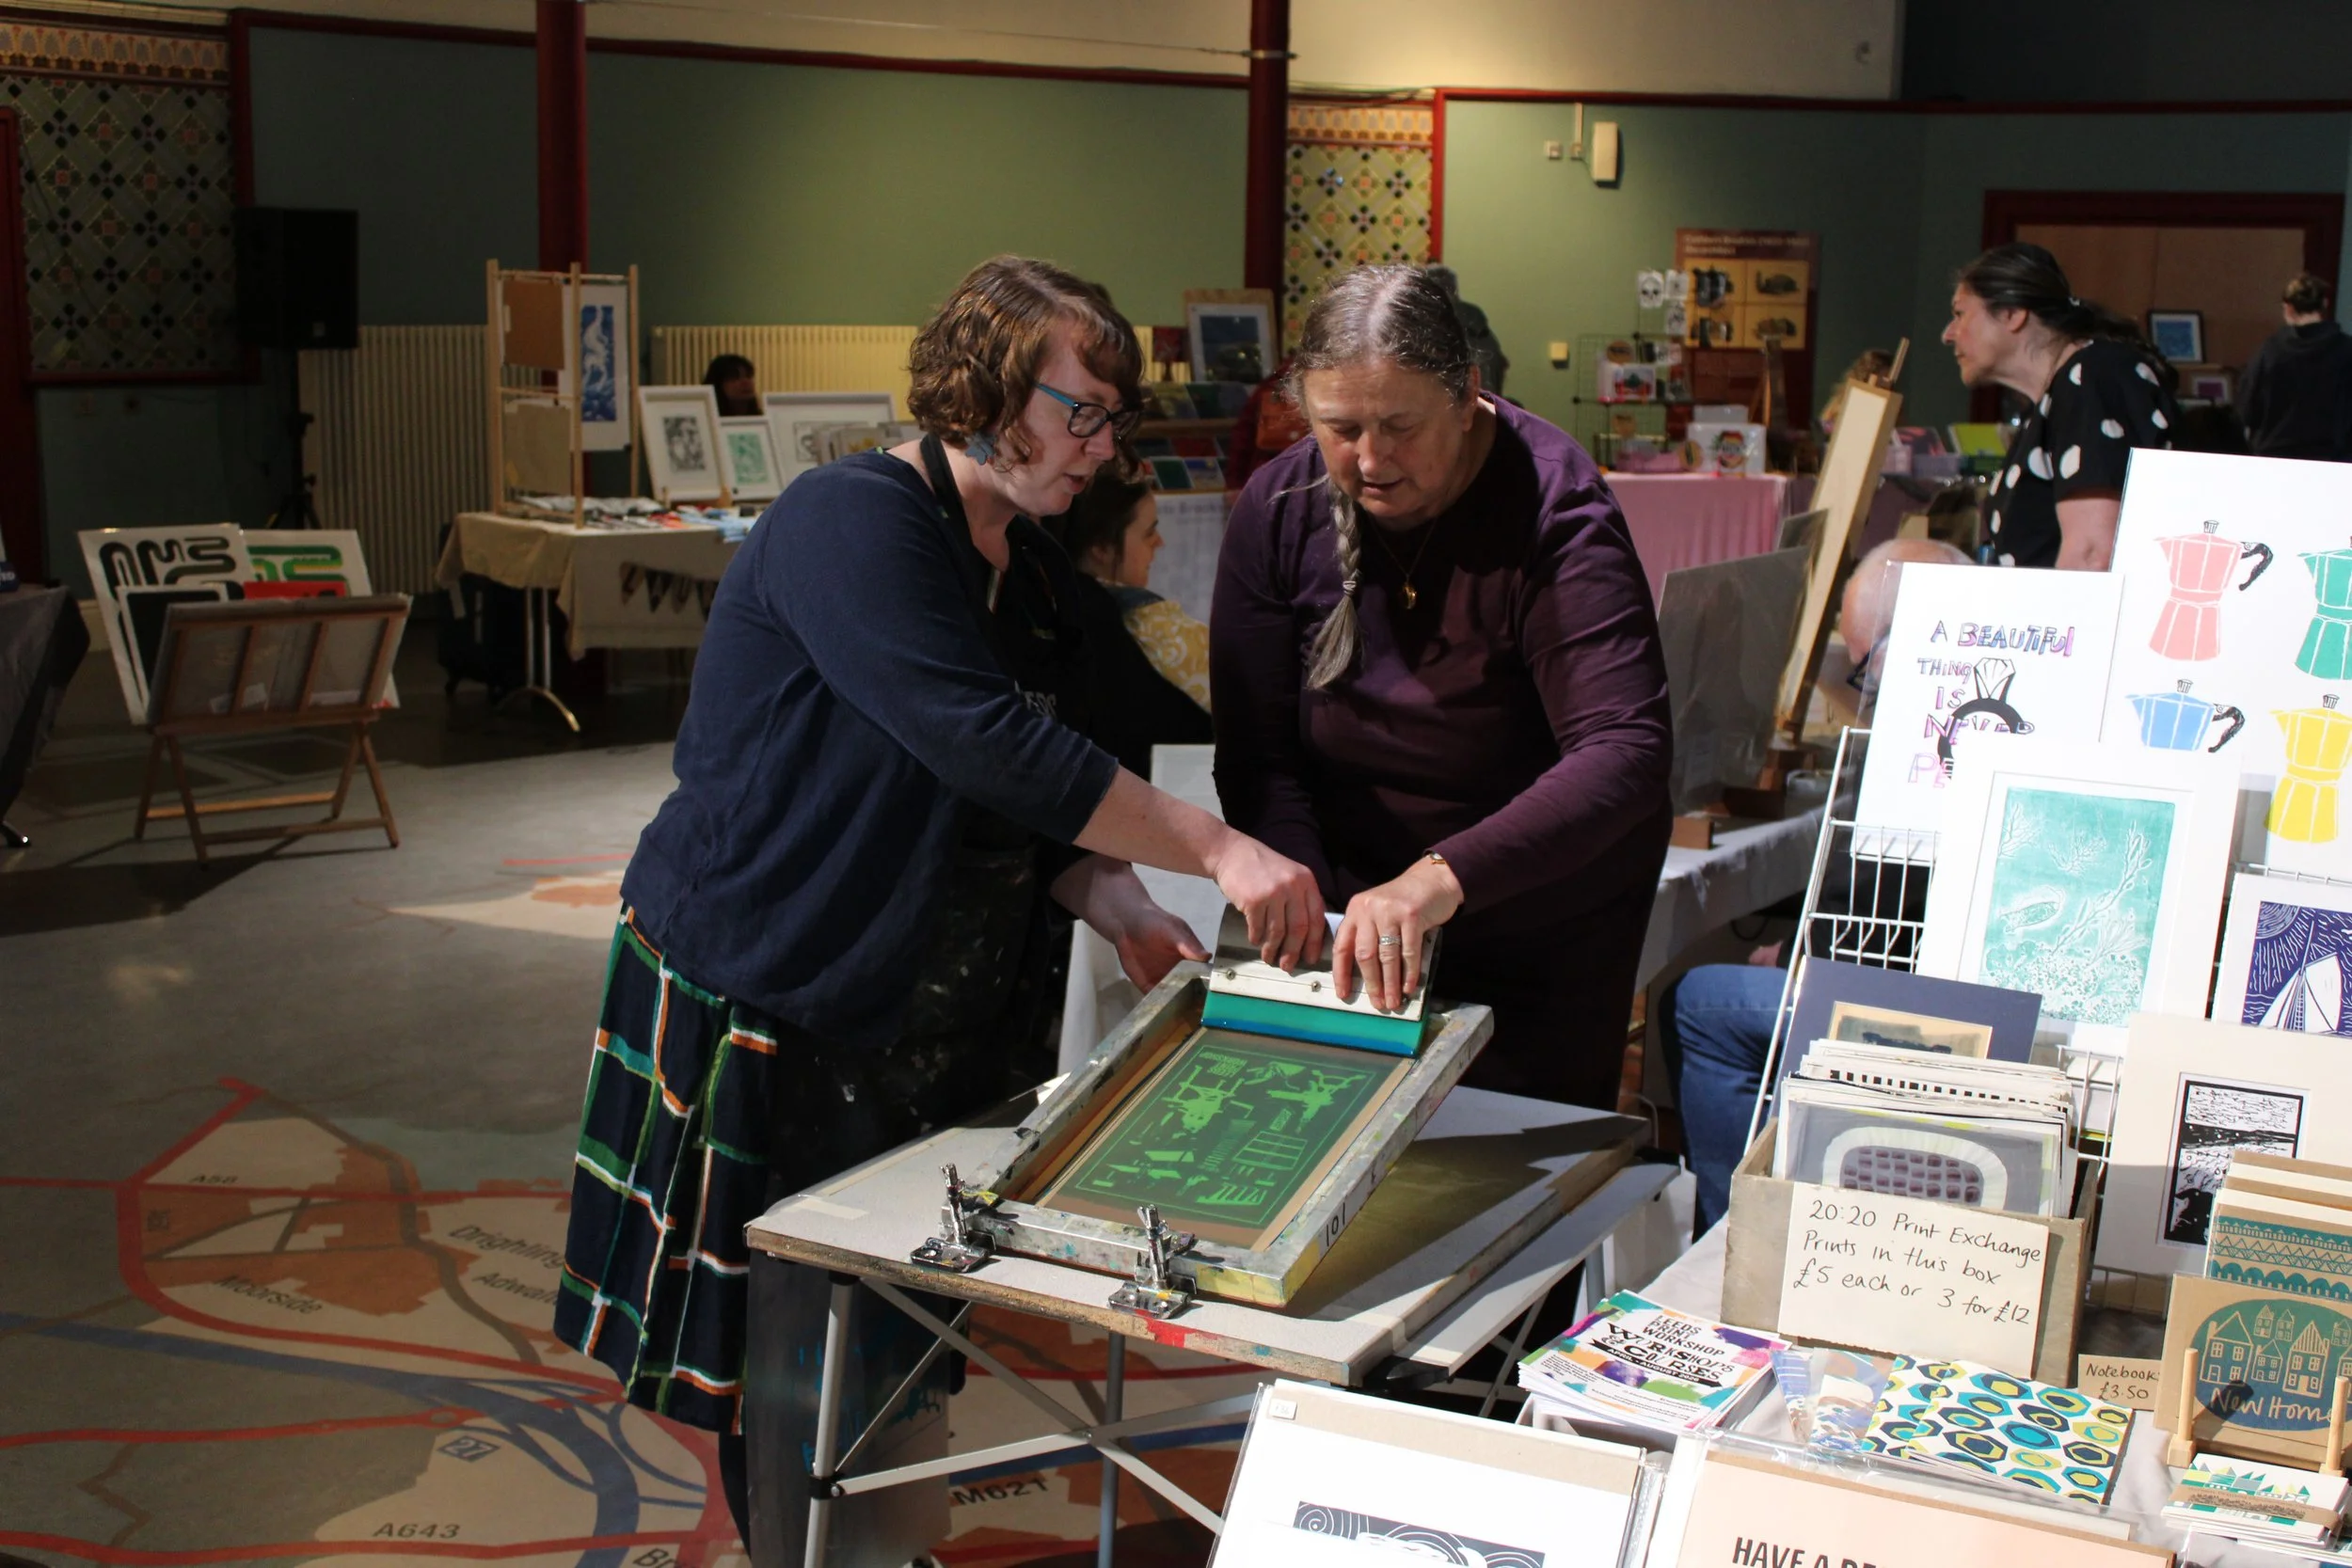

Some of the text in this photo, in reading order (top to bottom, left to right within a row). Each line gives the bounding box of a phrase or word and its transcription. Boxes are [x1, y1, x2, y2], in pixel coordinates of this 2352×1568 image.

[1931, 620, 1947, 642] A
[1935, 687, 1965, 709] IS
[1808, 1199, 2042, 1269] 20:20 Print Exchange
[1803, 1229, 2001, 1285] Prints in this box
[213, 1275, 323, 1314] Moorside
[1793, 1258, 2030, 1324] £5 each or 3 for £12
[1649, 1321, 1692, 1339] PRINT
[1656, 1315, 1702, 1335] LEEDS
[1607, 1323, 1735, 1372] WORKSHOPS
[1643, 1326, 1725, 1356] WORKSHOP
[1607, 1348, 1633, 1361] APRIL
[1640, 1362, 1677, 1377] AUGUST
[2086, 1362, 2160, 1381] Notebook
[2098, 1382, 2149, 1402] £3.50
[2210, 1386, 2265, 1419] New
[453, 1435, 490, 1454] 27
[952, 1478, 1049, 1505] M621
[373, 1522, 461, 1540] A643
[1732, 1536, 1805, 1568] HAVE
